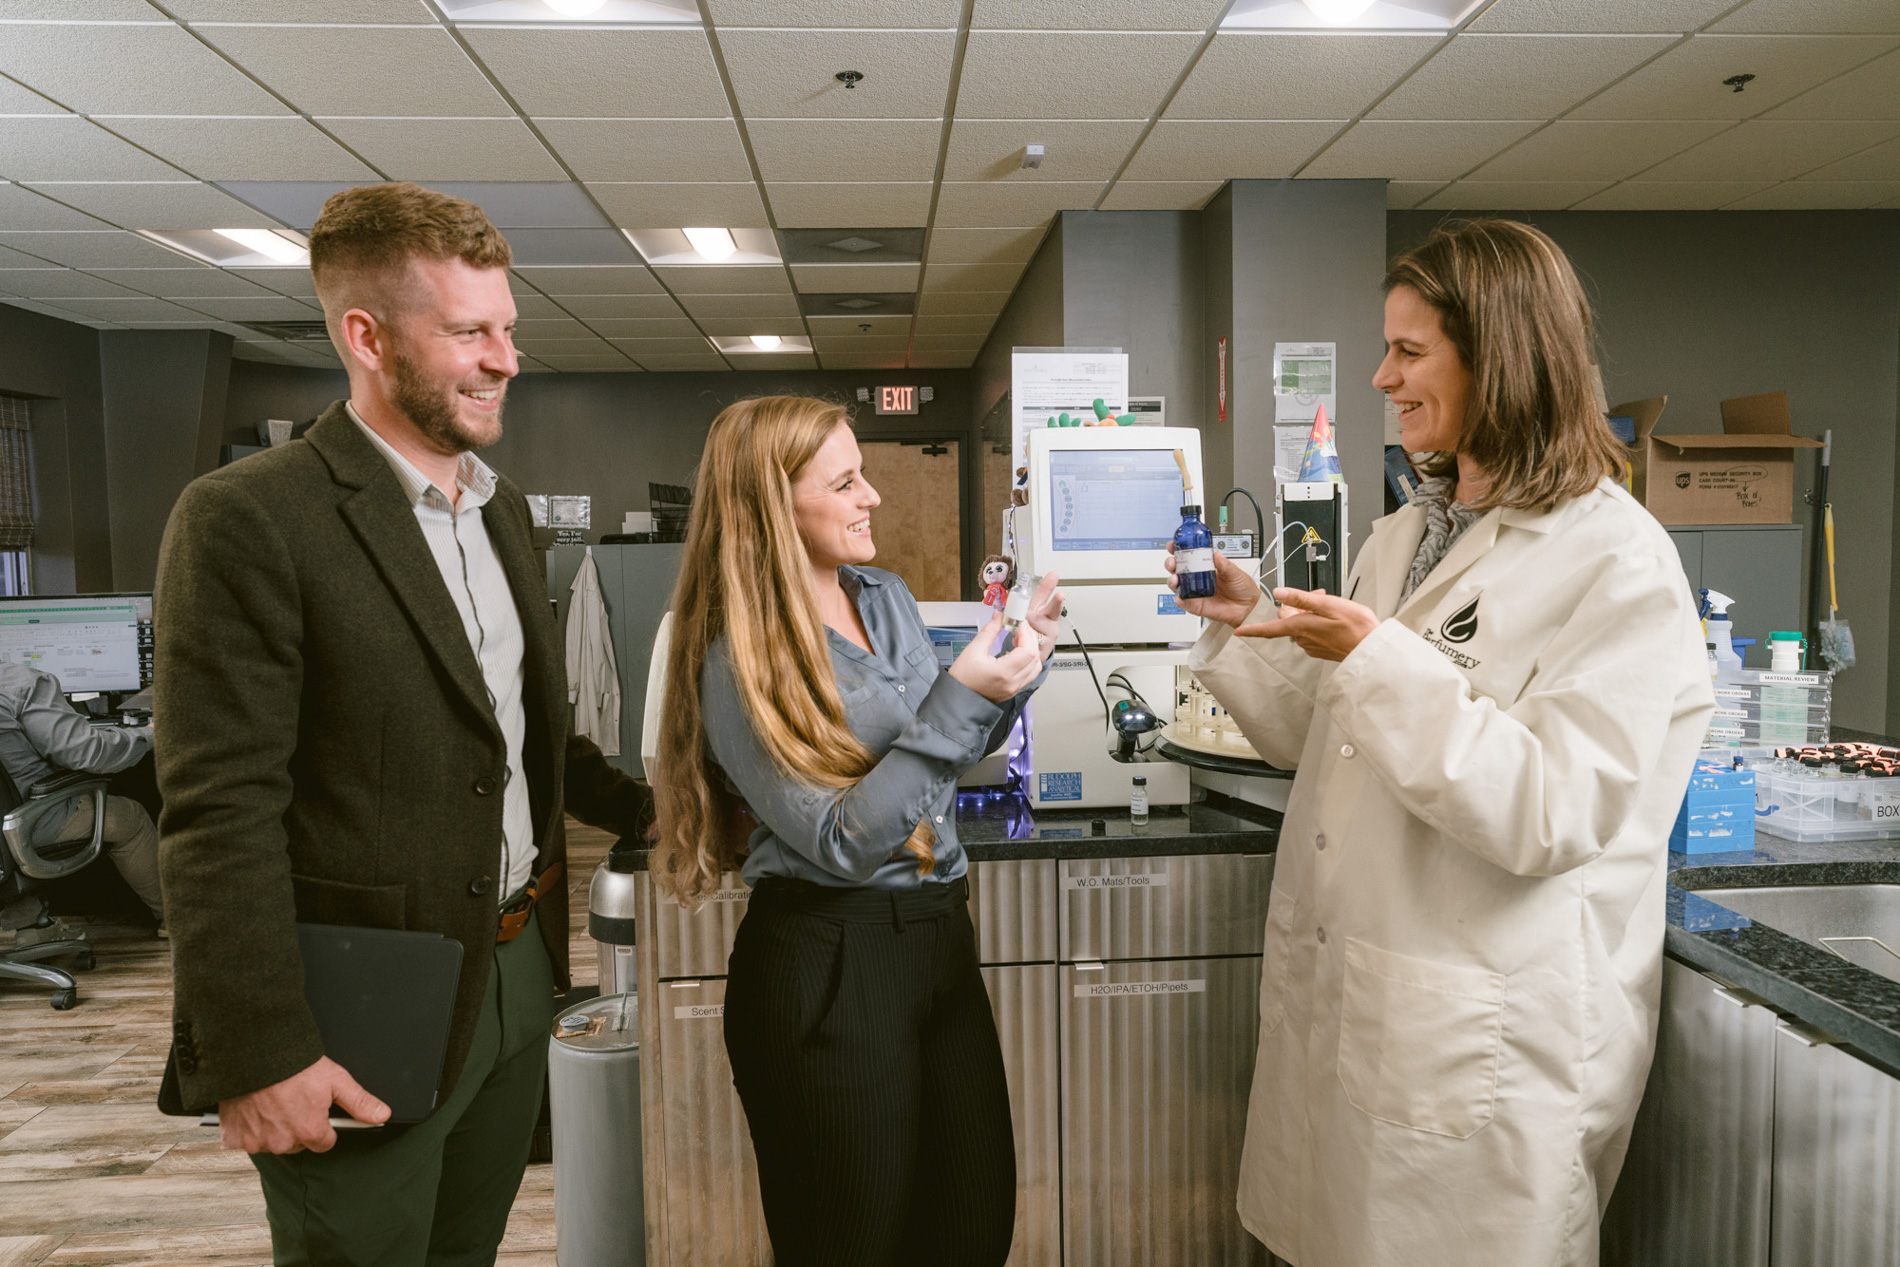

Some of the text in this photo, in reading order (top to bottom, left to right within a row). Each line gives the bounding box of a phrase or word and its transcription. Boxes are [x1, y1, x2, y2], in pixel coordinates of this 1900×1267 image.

[882, 387, 913, 411] EXIT
[1048, 772, 1081, 780] RUDOLPH
[1877, 805, 1900, 818] BOX
[1076, 876, 1150, 887] W.O. Mats/Tools
[1090, 982, 1189, 995] H2O/IPA/ETOH/Pipets
[691, 1006, 718, 1017] Scent
